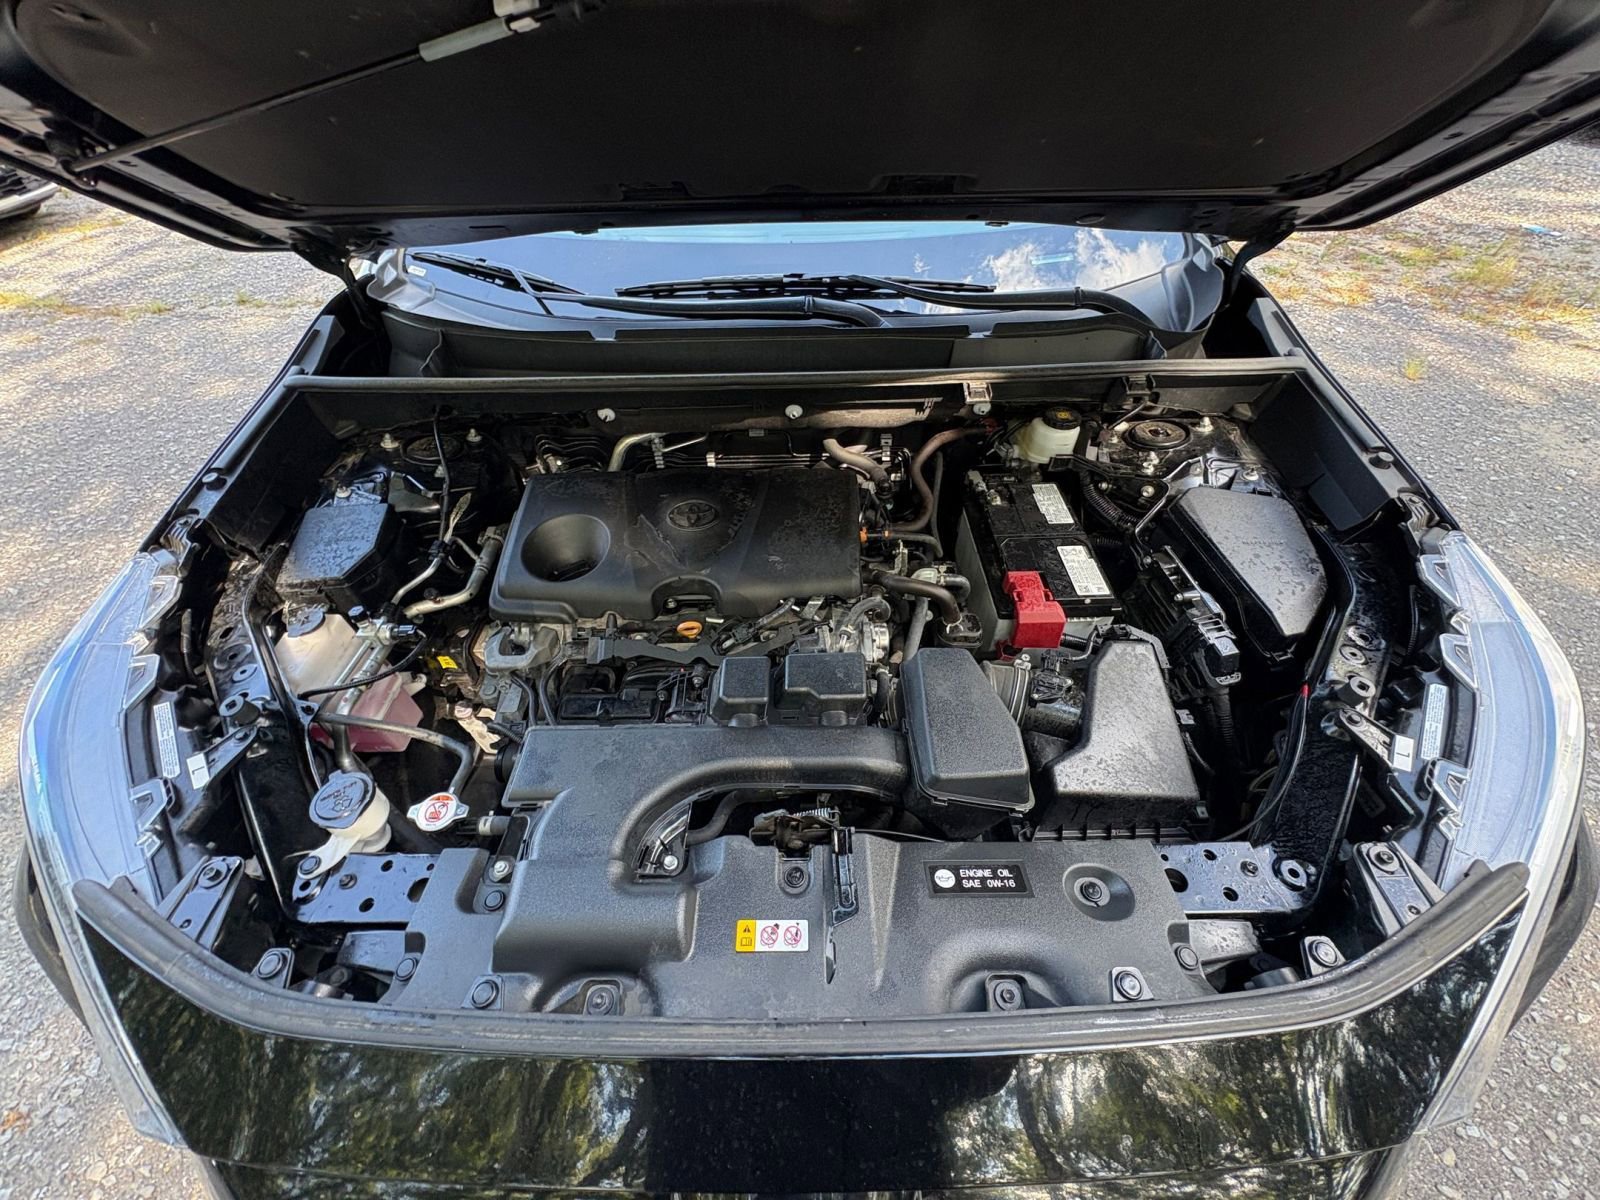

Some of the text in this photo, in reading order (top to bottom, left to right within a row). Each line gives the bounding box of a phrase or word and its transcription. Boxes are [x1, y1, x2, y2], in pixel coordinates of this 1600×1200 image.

[959, 869, 1013, 878] ENGINE OIL
[962, 879, 1016, 888] SAE 0W-16
